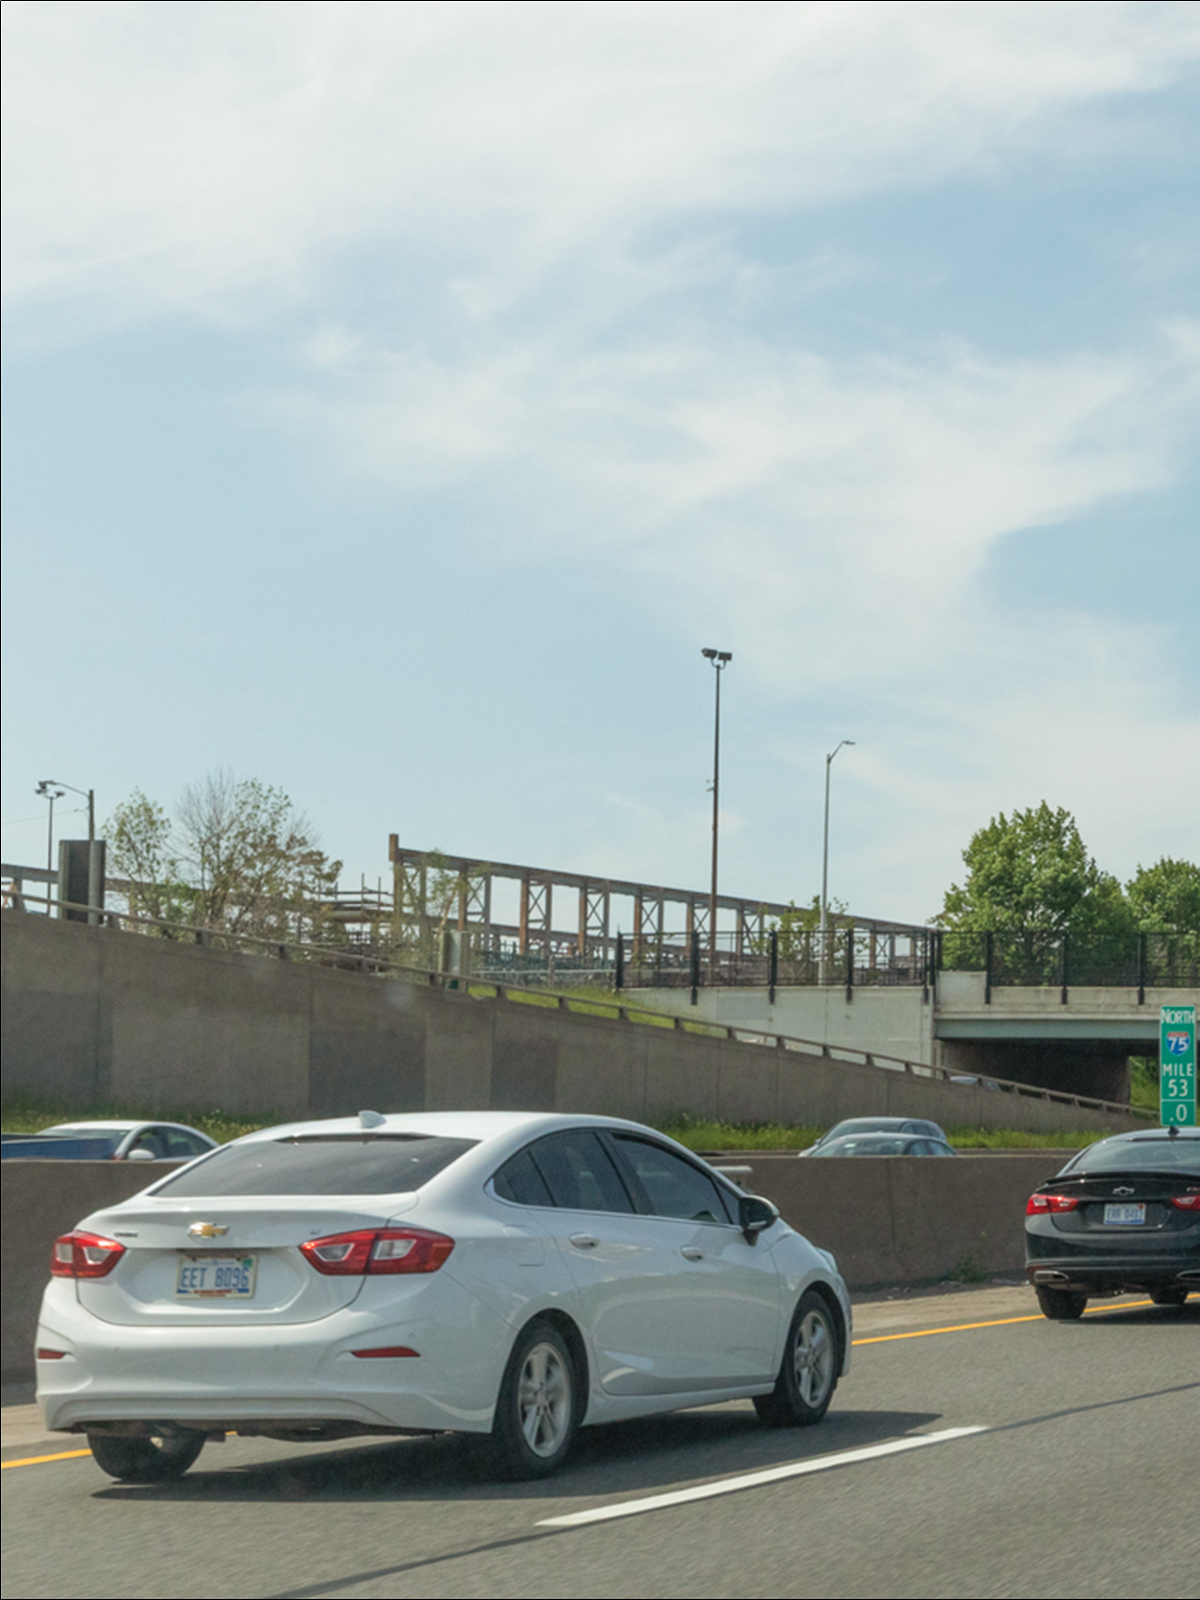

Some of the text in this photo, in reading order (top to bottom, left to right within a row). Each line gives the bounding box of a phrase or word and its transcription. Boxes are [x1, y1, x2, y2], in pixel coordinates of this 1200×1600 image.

[1160, 1009, 1195, 1024] NORTH
[1168, 1037, 1189, 1052] 75
[1162, 1063, 1194, 1077] MILE
[1168, 1079, 1188, 1097] 53
[181, 1266, 250, 1288] EET 8096
